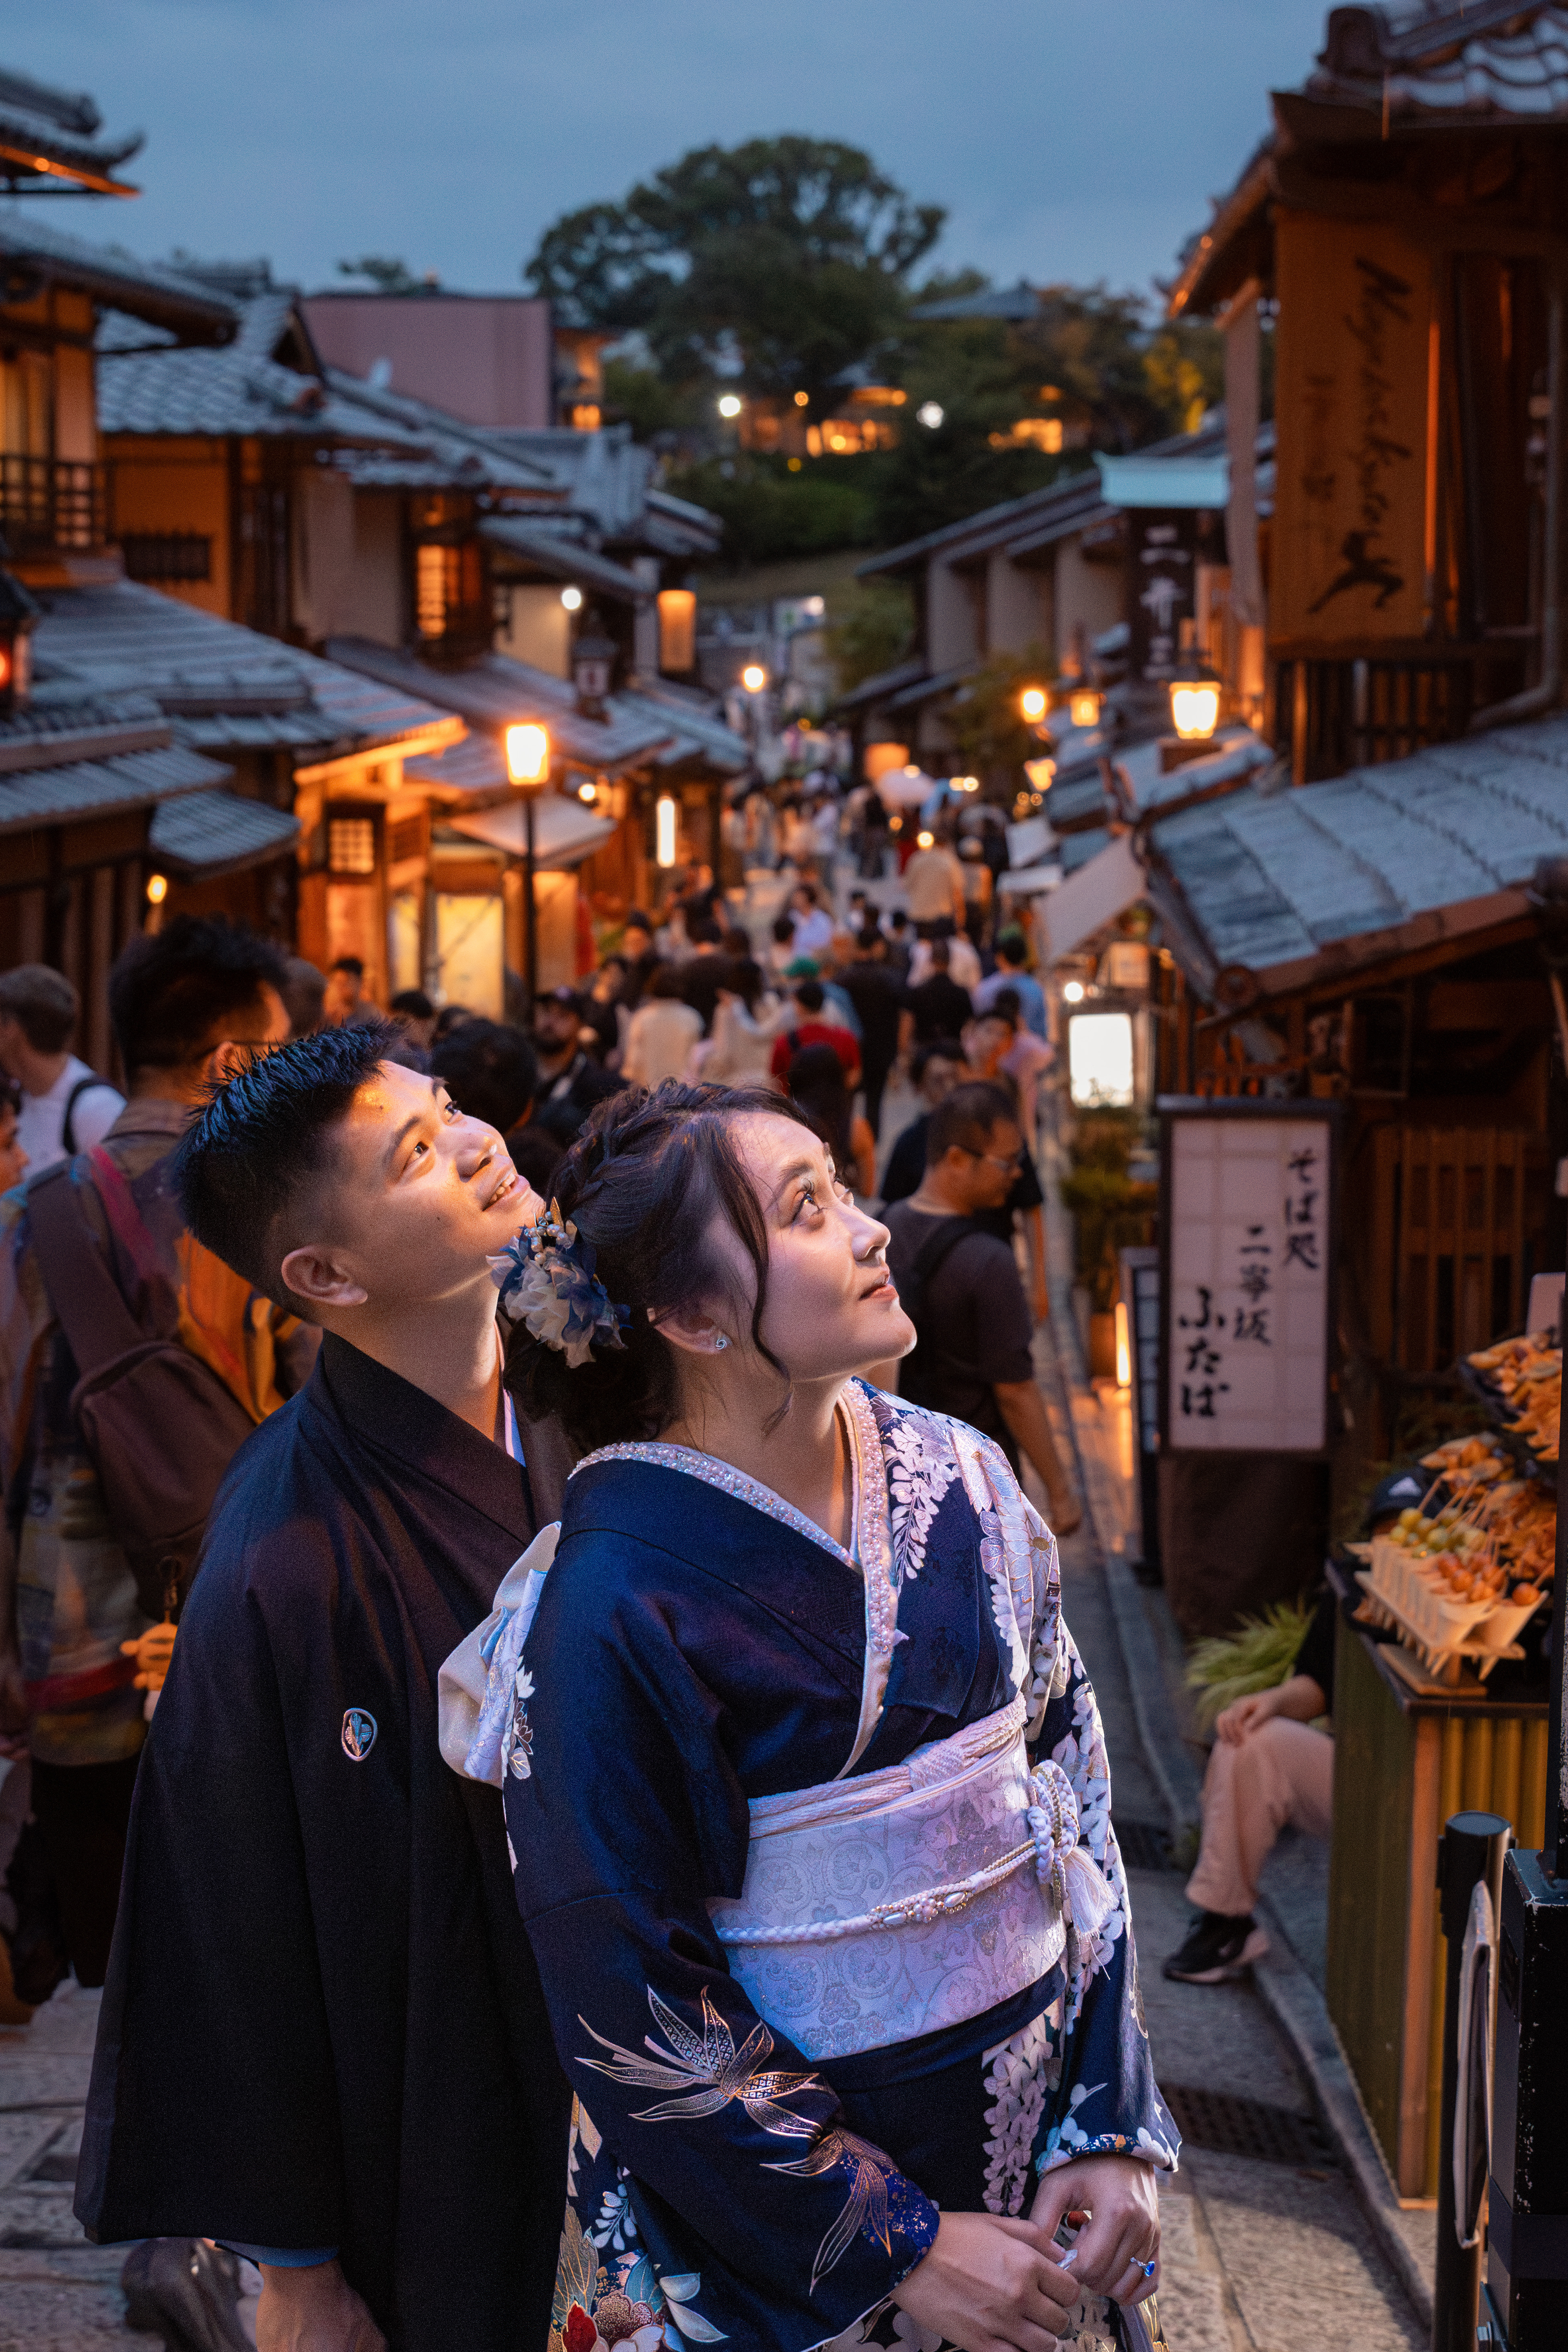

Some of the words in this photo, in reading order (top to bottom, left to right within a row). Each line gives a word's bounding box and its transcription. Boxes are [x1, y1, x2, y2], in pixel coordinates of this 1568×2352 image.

[1283, 1148, 1320, 1270] そば処
[1178, 1287, 1229, 1417] ふたば
